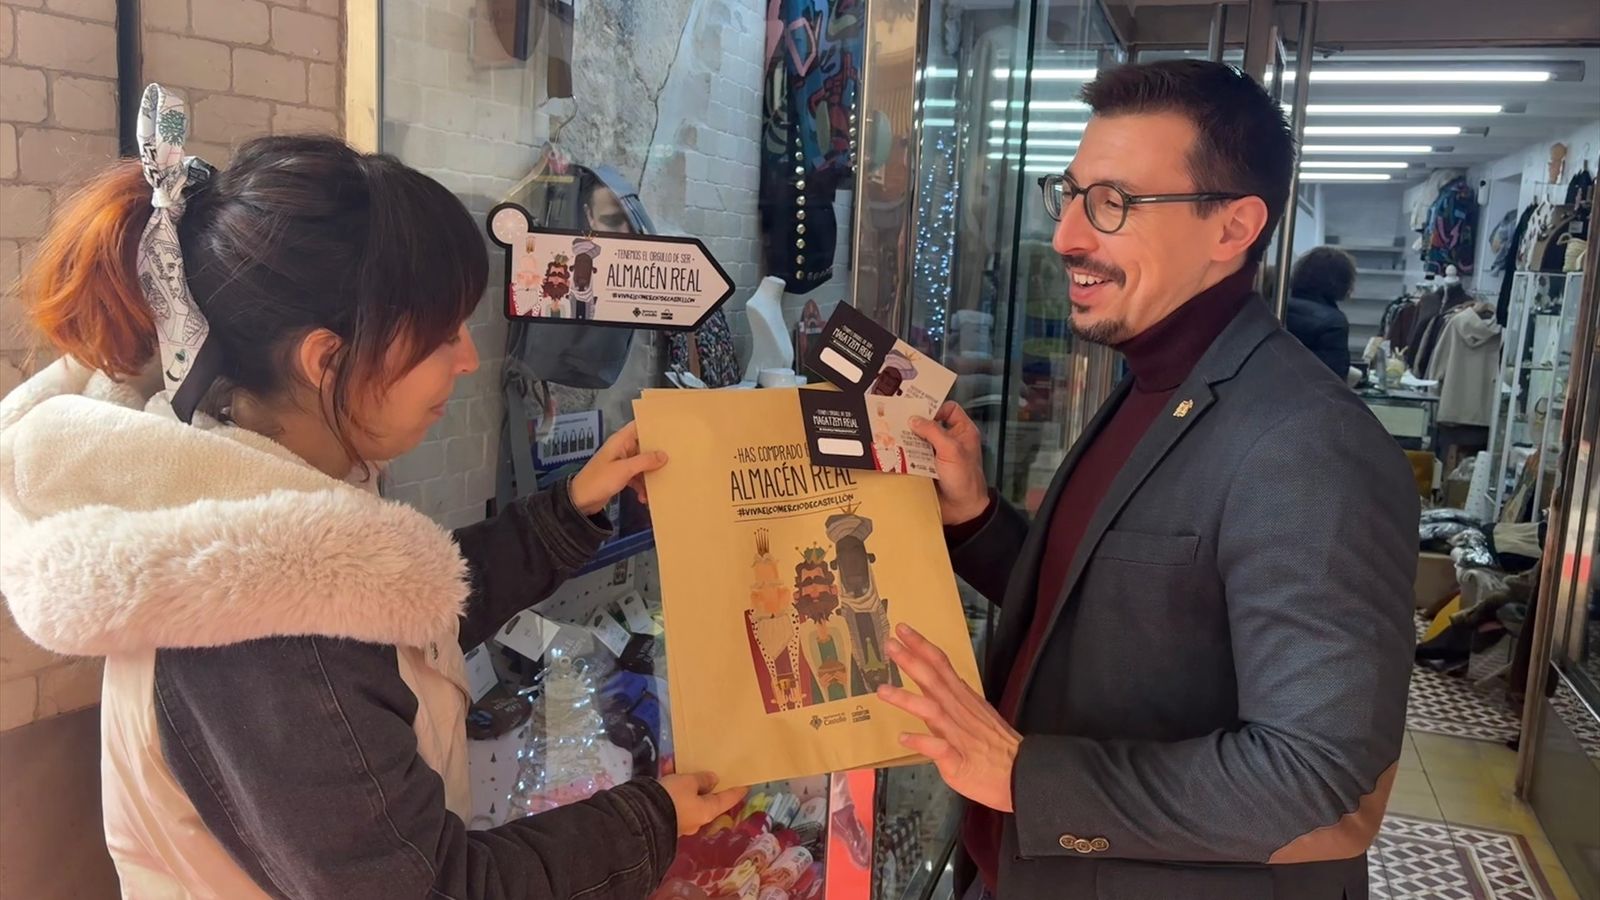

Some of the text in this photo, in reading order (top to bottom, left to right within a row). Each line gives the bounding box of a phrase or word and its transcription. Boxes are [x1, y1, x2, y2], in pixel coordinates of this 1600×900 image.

[617, 249, 691, 264] TENEMOS EL ORGULLO DE SER
[606, 262, 702, 292] ALMACÉN REAL
[832, 328, 861, 352] MAGATZEM
[813, 416, 843, 427] MAGATZEM
[737, 448, 757, 463] HAS
[757, 443, 803, 462] COMPRADO
[731, 463, 857, 502] ALMACÉN REAL
